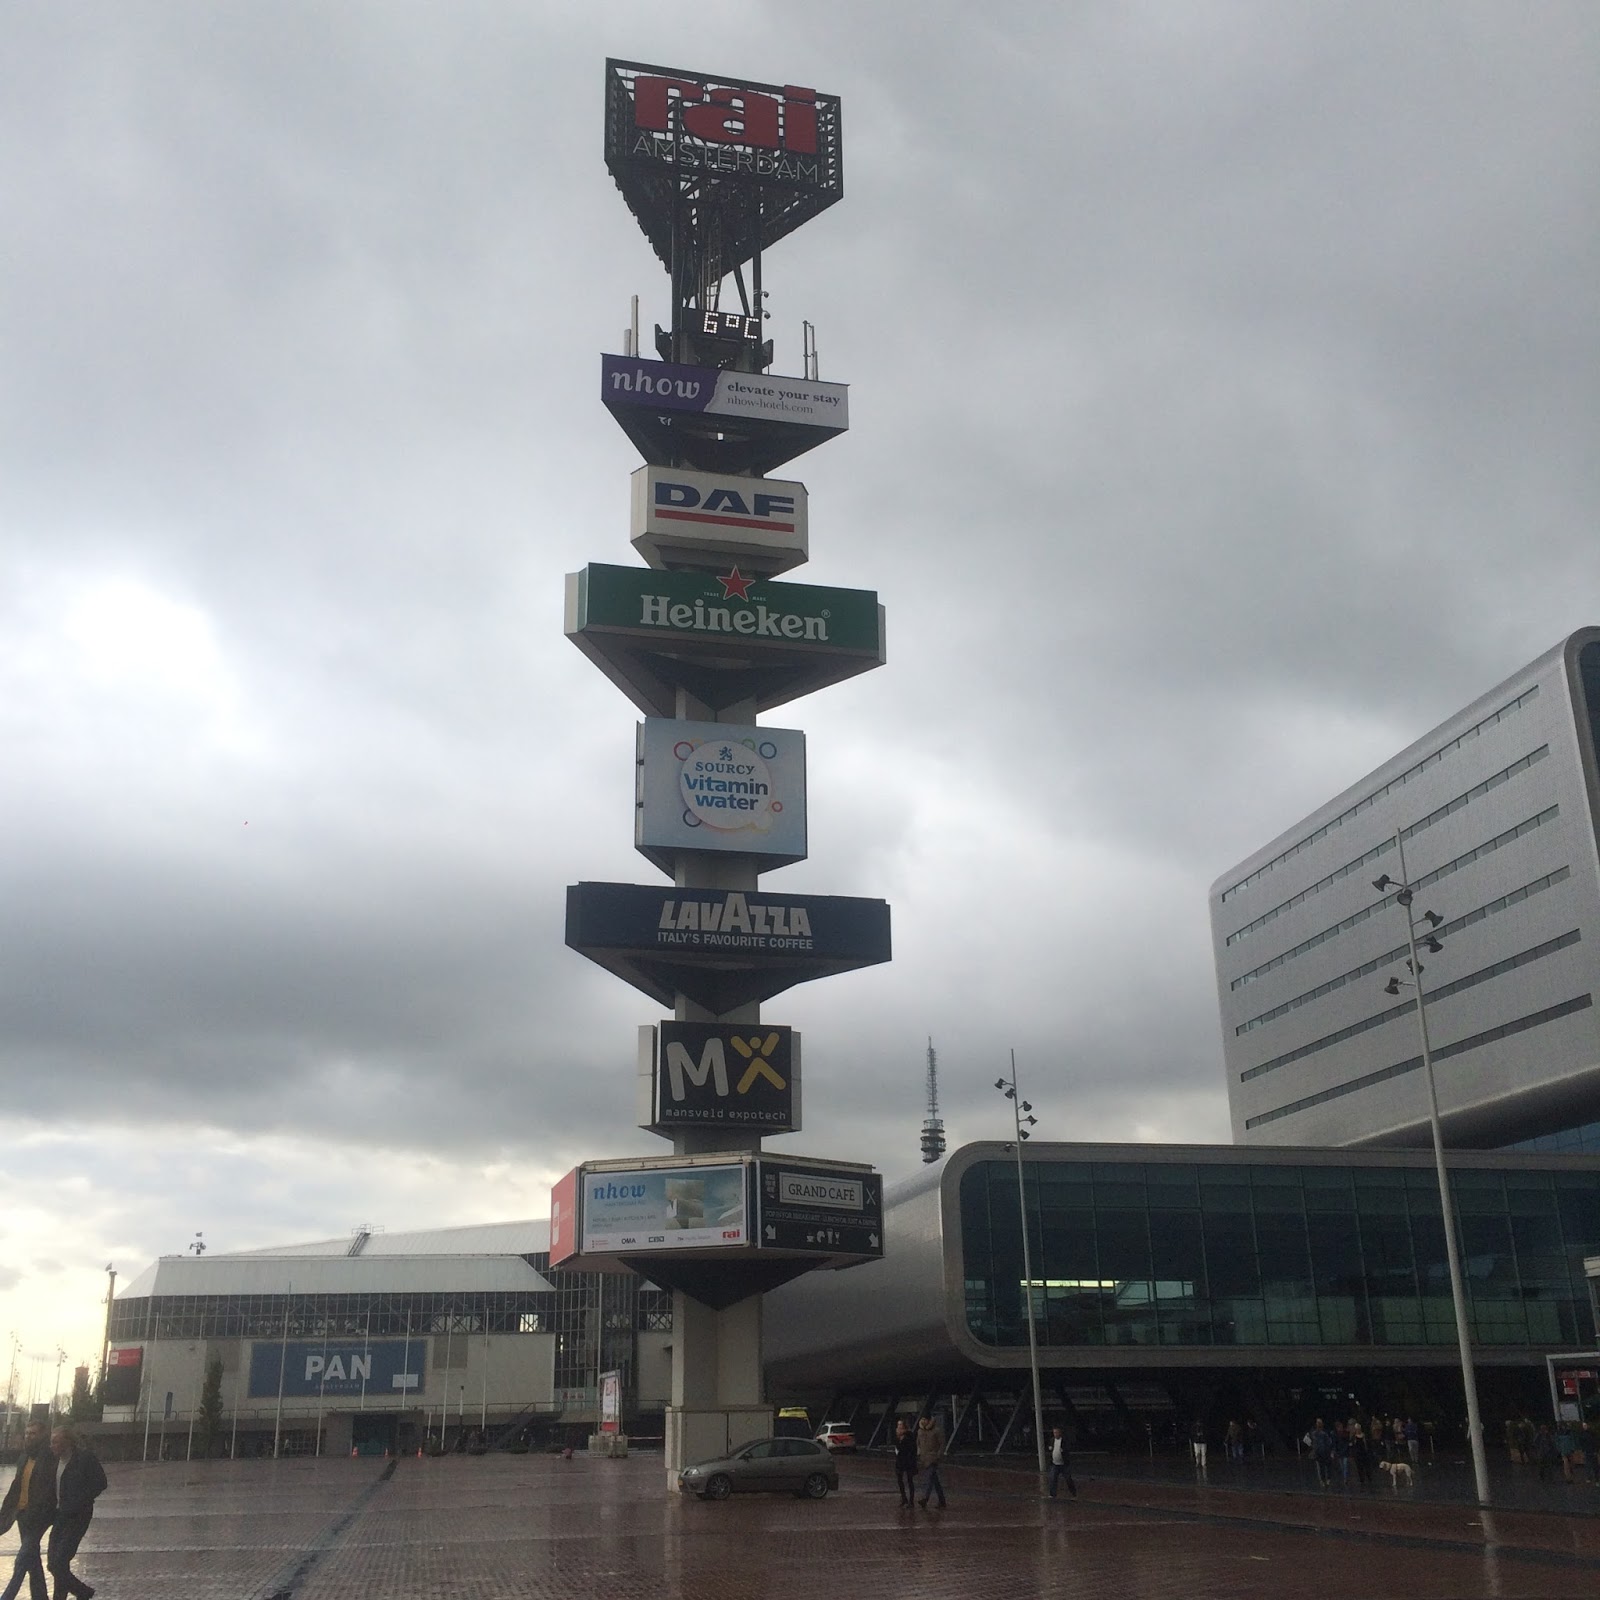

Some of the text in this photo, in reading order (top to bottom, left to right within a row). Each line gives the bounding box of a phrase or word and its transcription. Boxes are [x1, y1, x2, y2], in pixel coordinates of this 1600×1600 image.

[634, 75, 817, 154] rai
[633, 135, 818, 183] AMSTERDAM
[611, 369, 700, 399] nhow
[727, 382, 840, 407] elevate your stay
[727, 395, 814, 414] nhow-hotels.com
[655, 482, 794, 517] DAF
[640, 594, 829, 641] Heineken
[695, 761, 755, 774] SOURCY
[683, 773, 769, 795] Vitamin
[695, 794, 759, 811] water
[658, 892, 813, 937] LAVAZZA
[703, 933, 766, 948] FAVOURITE
[769, 937, 814, 950] COFFEE
[665, 1107, 786, 1121] mansveld expotech
[593, 1182, 646, 1200] nhow
[788, 1183, 855, 1201] GRAND CAFÉ
[722, 1229, 740, 1239] rai
[305, 1354, 372, 1381] PAN
